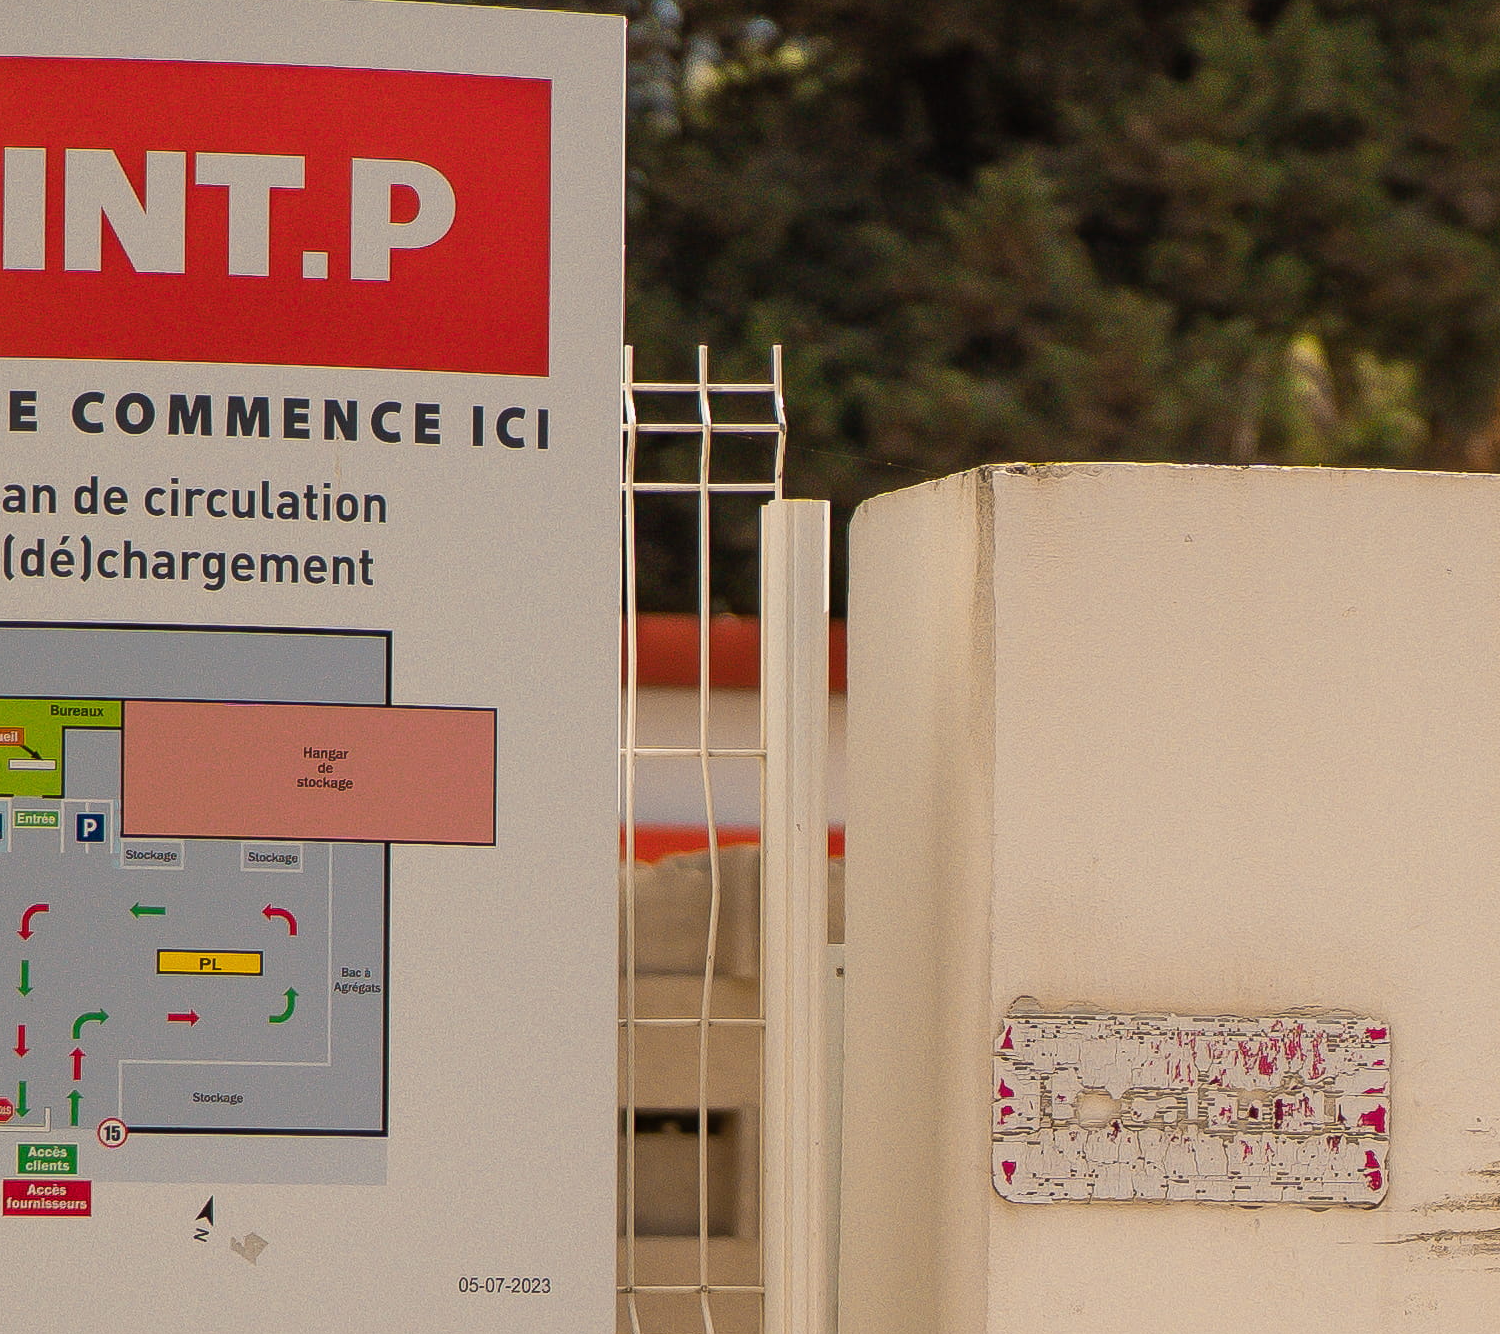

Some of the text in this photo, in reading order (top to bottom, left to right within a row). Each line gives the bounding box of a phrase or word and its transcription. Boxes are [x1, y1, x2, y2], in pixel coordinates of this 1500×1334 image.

[72, 392, 440, 444] COMMENCE
[473, 406, 548, 449] ICI
[75, 476, 128, 515] de
[145, 478, 386, 522] circulation
[4, 534, 373, 591] (dé)chargement
[50, 705, 105, 718] Bureaux
[303, 747, 349, 761] Hangar
[317, 762, 334, 775] de
[296, 776, 354, 791] stockage
[16, 812, 56, 824] Entrée
[82, 819, 98, 837] P
[125, 849, 178, 861] Stockage
[247, 851, 299, 864] Stockage
[199, 958, 222, 971] PL
[341, 967, 371, 978] Bac à
[333, 982, 382, 994] Agrégats
[192, 1092, 244, 1105] Stockage
[103, 1125, 121, 1142] 15
[27, 1146, 68, 1159] Accès
[25, 1160, 70, 1172] clients
[26, 1184, 67, 1197] Accès
[6, 1197, 88, 1211] fournisseurs
[194, 1228, 210, 1243] N
[459, 1277, 551, 1293] 05-07-2023
